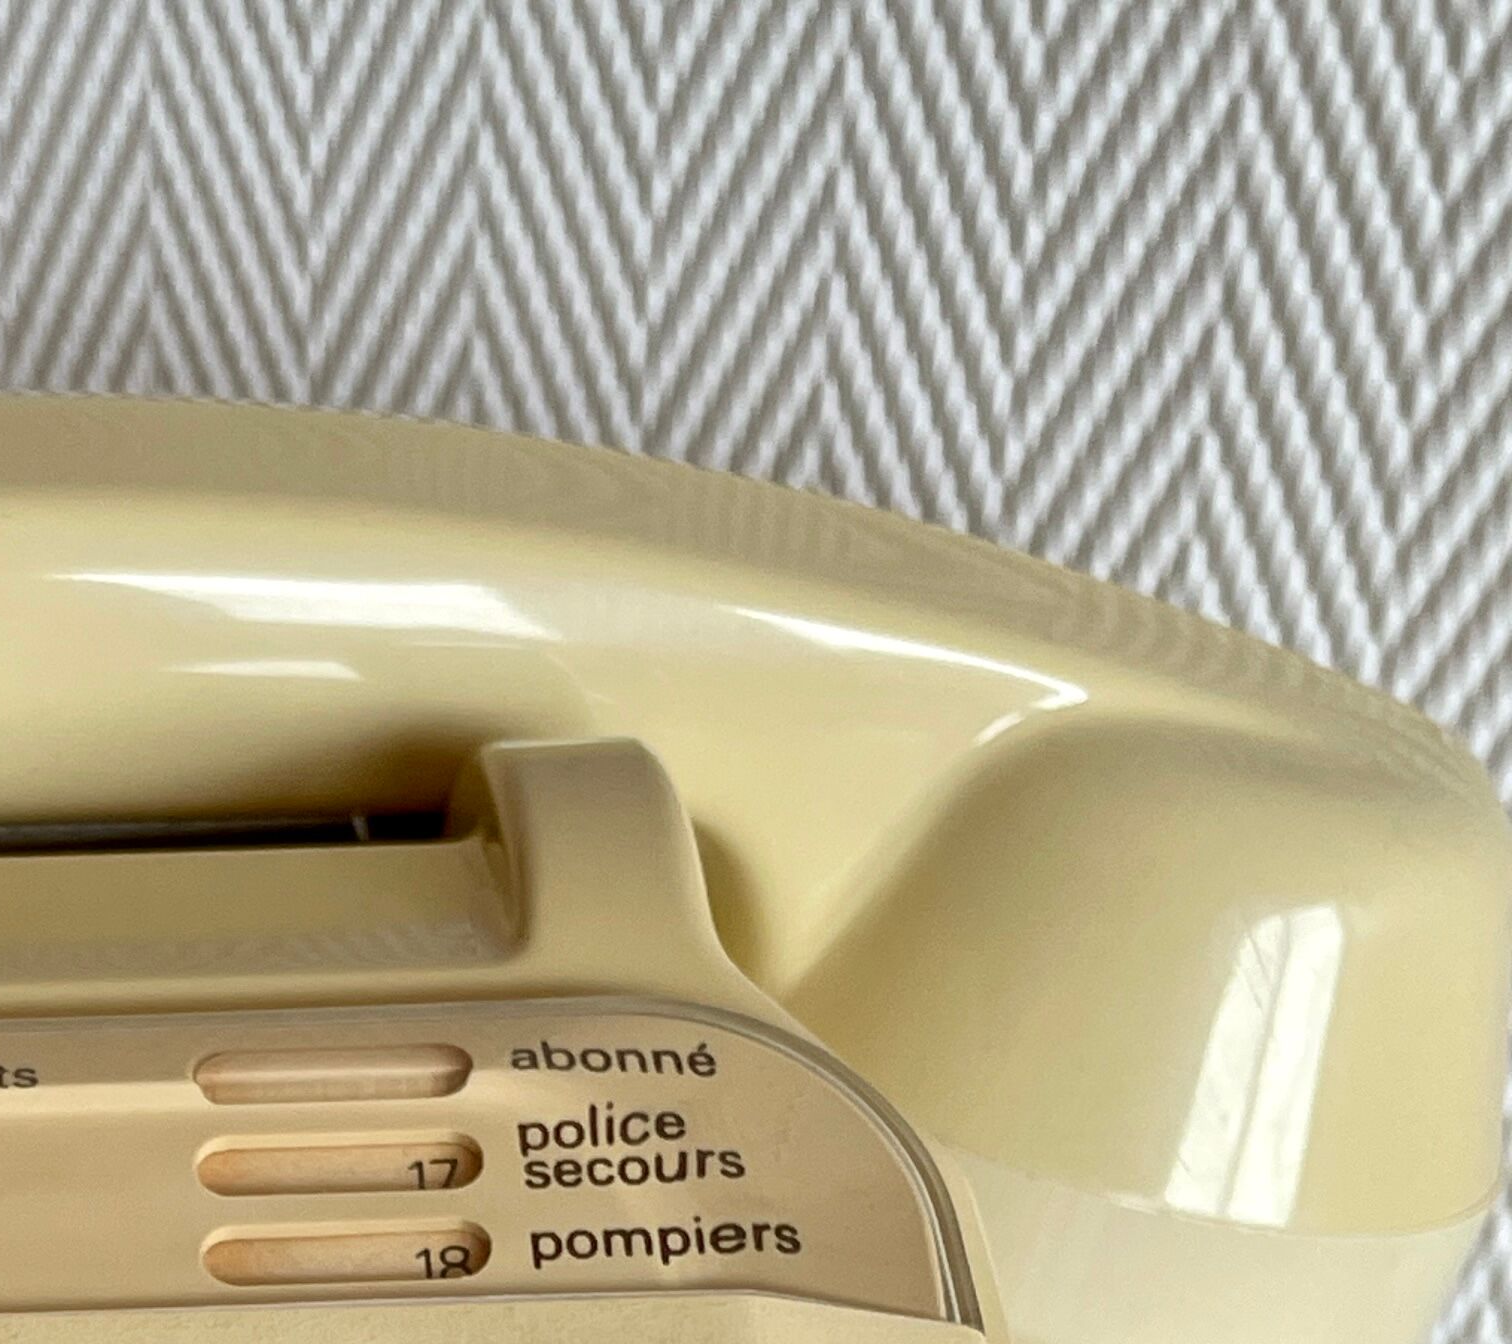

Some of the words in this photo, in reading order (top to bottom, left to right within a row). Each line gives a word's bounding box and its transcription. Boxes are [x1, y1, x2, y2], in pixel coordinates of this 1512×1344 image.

[510, 1039, 717, 1078] abonné
[517, 1102, 687, 1158] police
[407, 1158, 459, 1190] 17
[523, 1147, 746, 1190] secours
[414, 1245, 473, 1280] 18
[530, 1215, 802, 1270] pompiers
